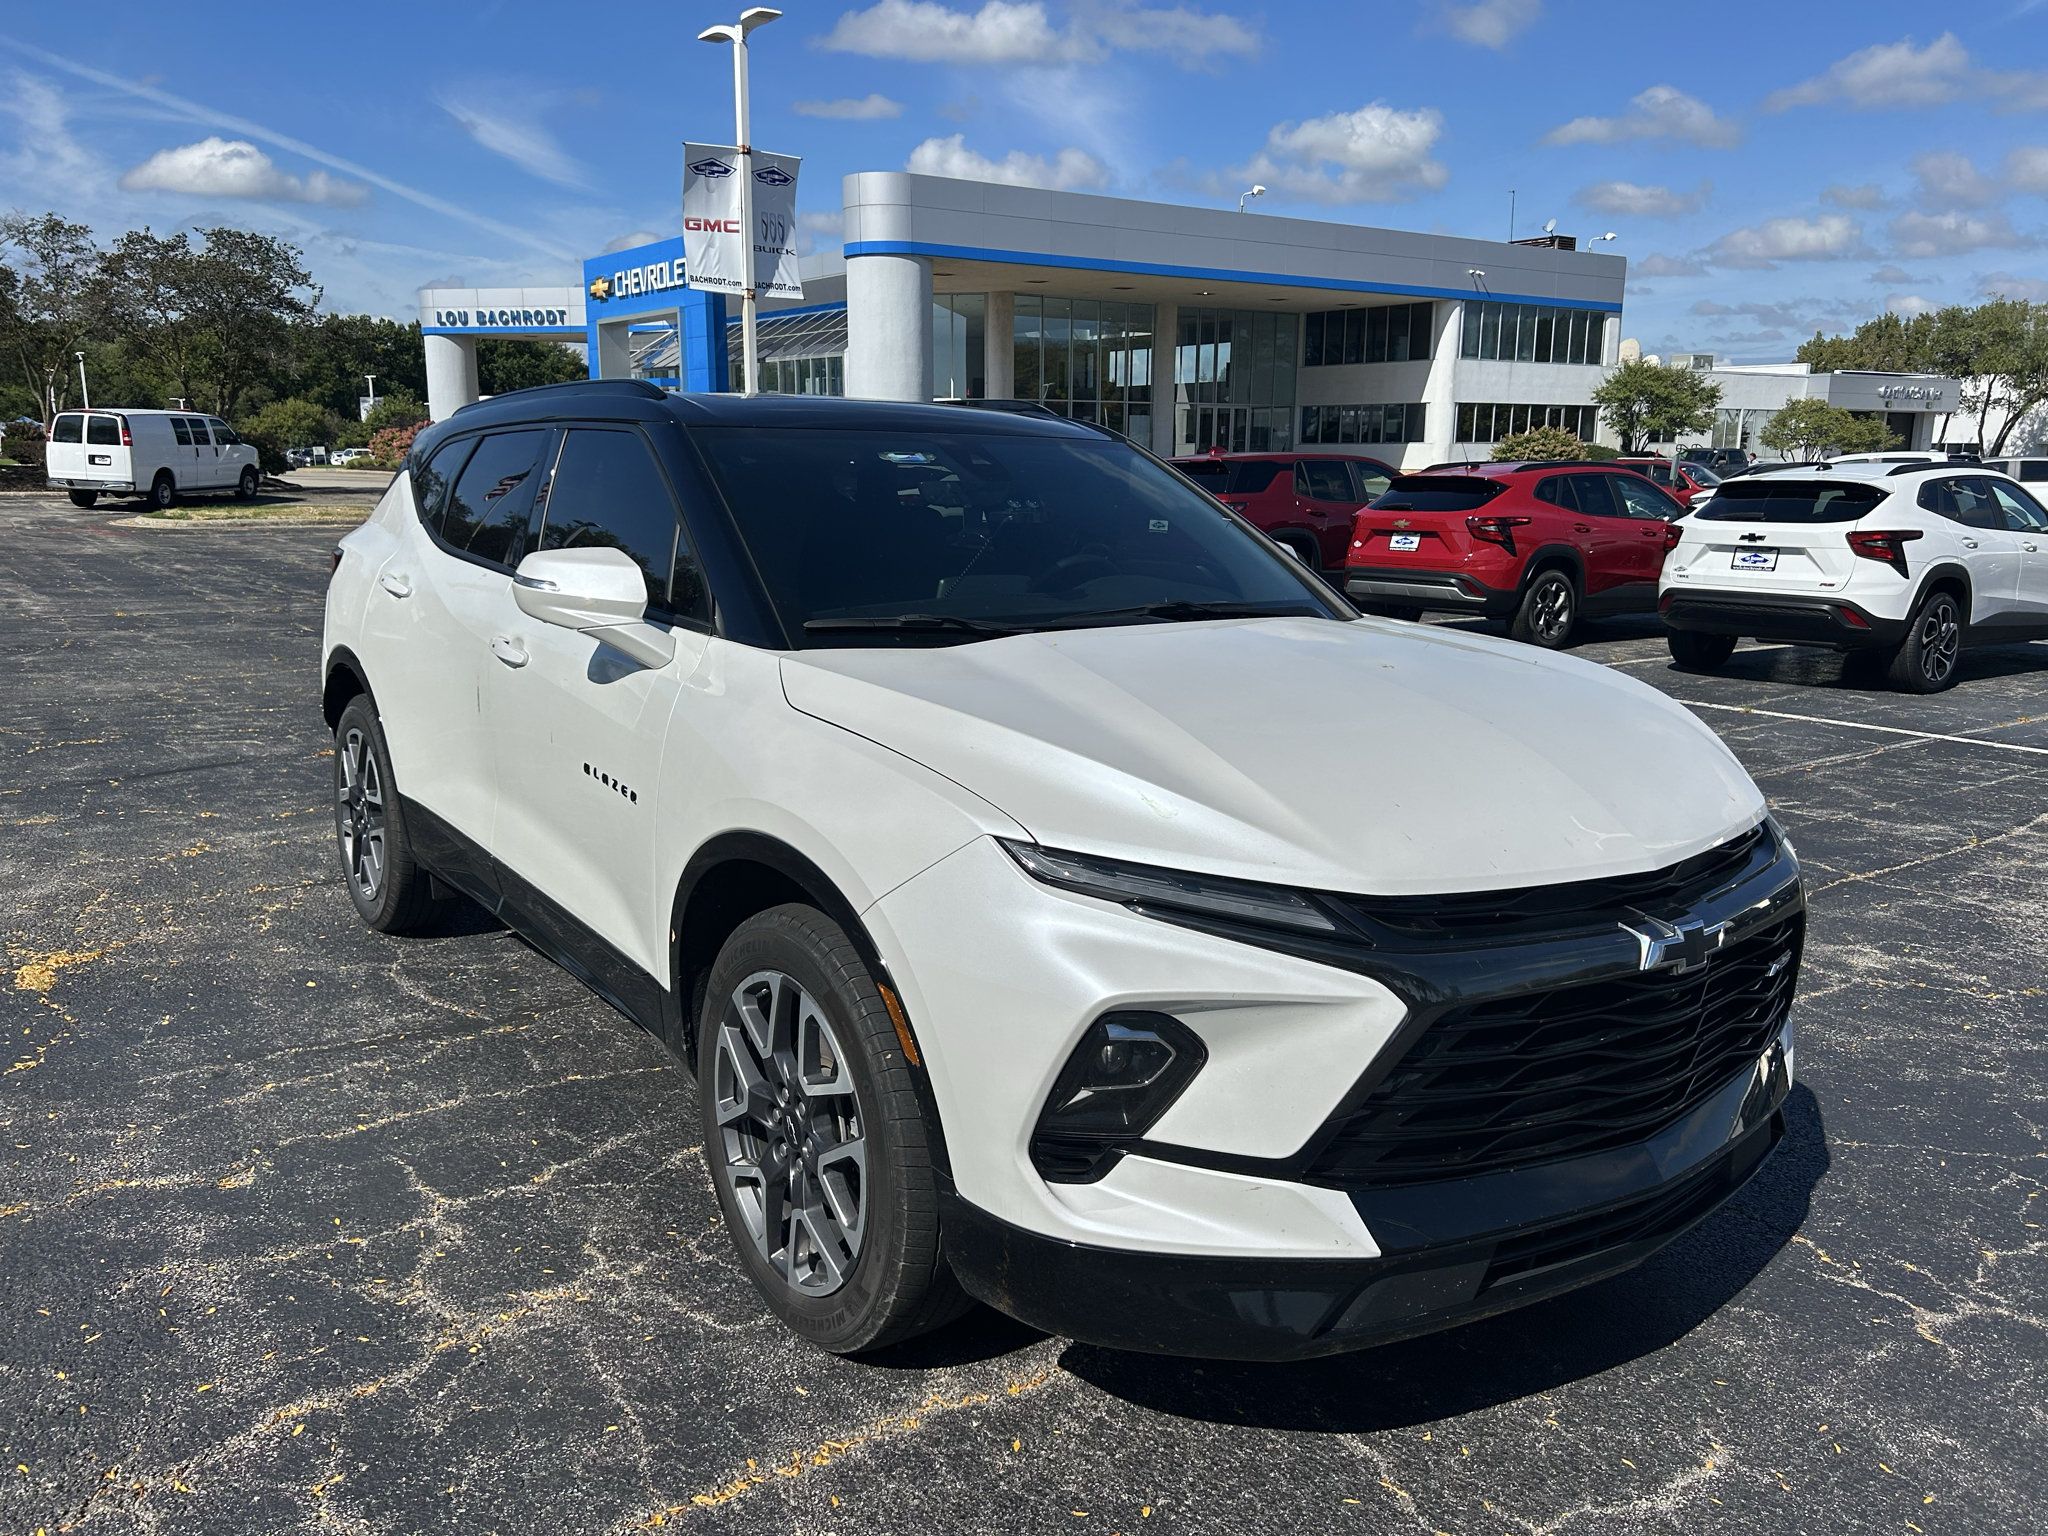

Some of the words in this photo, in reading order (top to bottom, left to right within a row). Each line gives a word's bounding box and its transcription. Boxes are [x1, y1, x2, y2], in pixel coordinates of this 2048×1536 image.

[684, 216, 740, 233] GMC
[753, 244, 796, 256] BUICK
[689, 274, 742, 287] BACHRODT.com
[436, 310, 469, 327] LOU
[476, 309, 567, 326] BACHRODT
[583, 762, 637, 805] BLAZER
